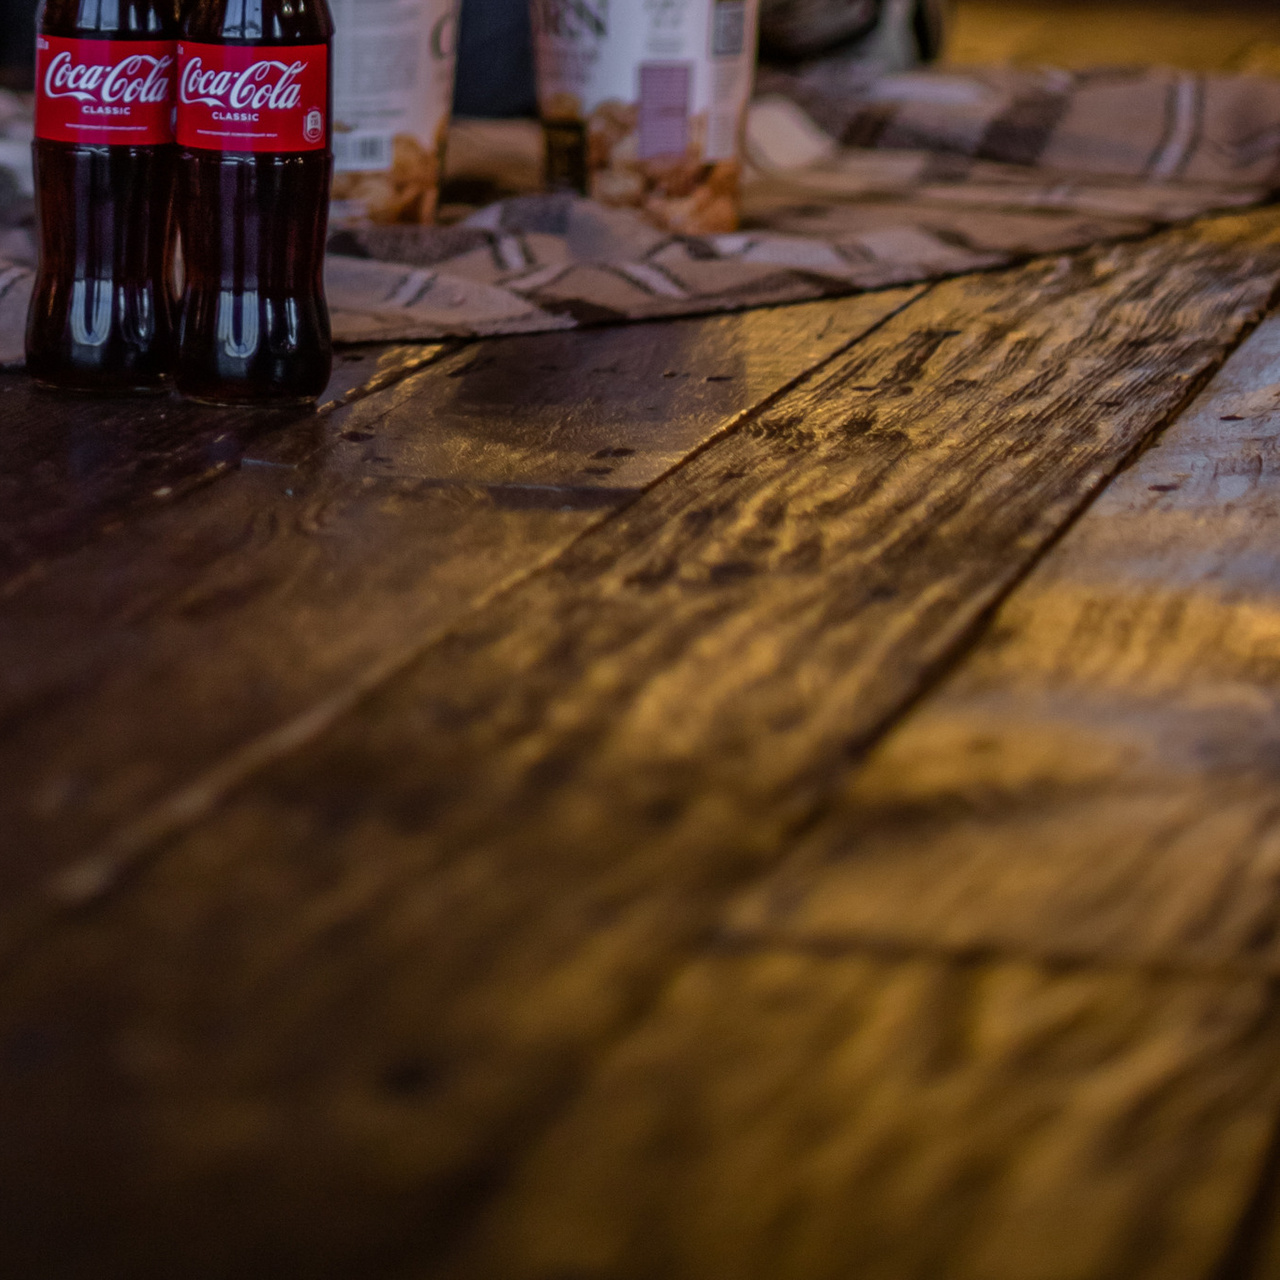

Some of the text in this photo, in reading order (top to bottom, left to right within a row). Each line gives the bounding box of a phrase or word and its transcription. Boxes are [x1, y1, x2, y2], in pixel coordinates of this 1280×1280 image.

[44, 51, 173, 103] Coca-Cola
[180, 56, 308, 109] Coca-Cola
[81, 104, 131, 115] CLASSIC
[211, 111, 260, 122] CLASSIC
